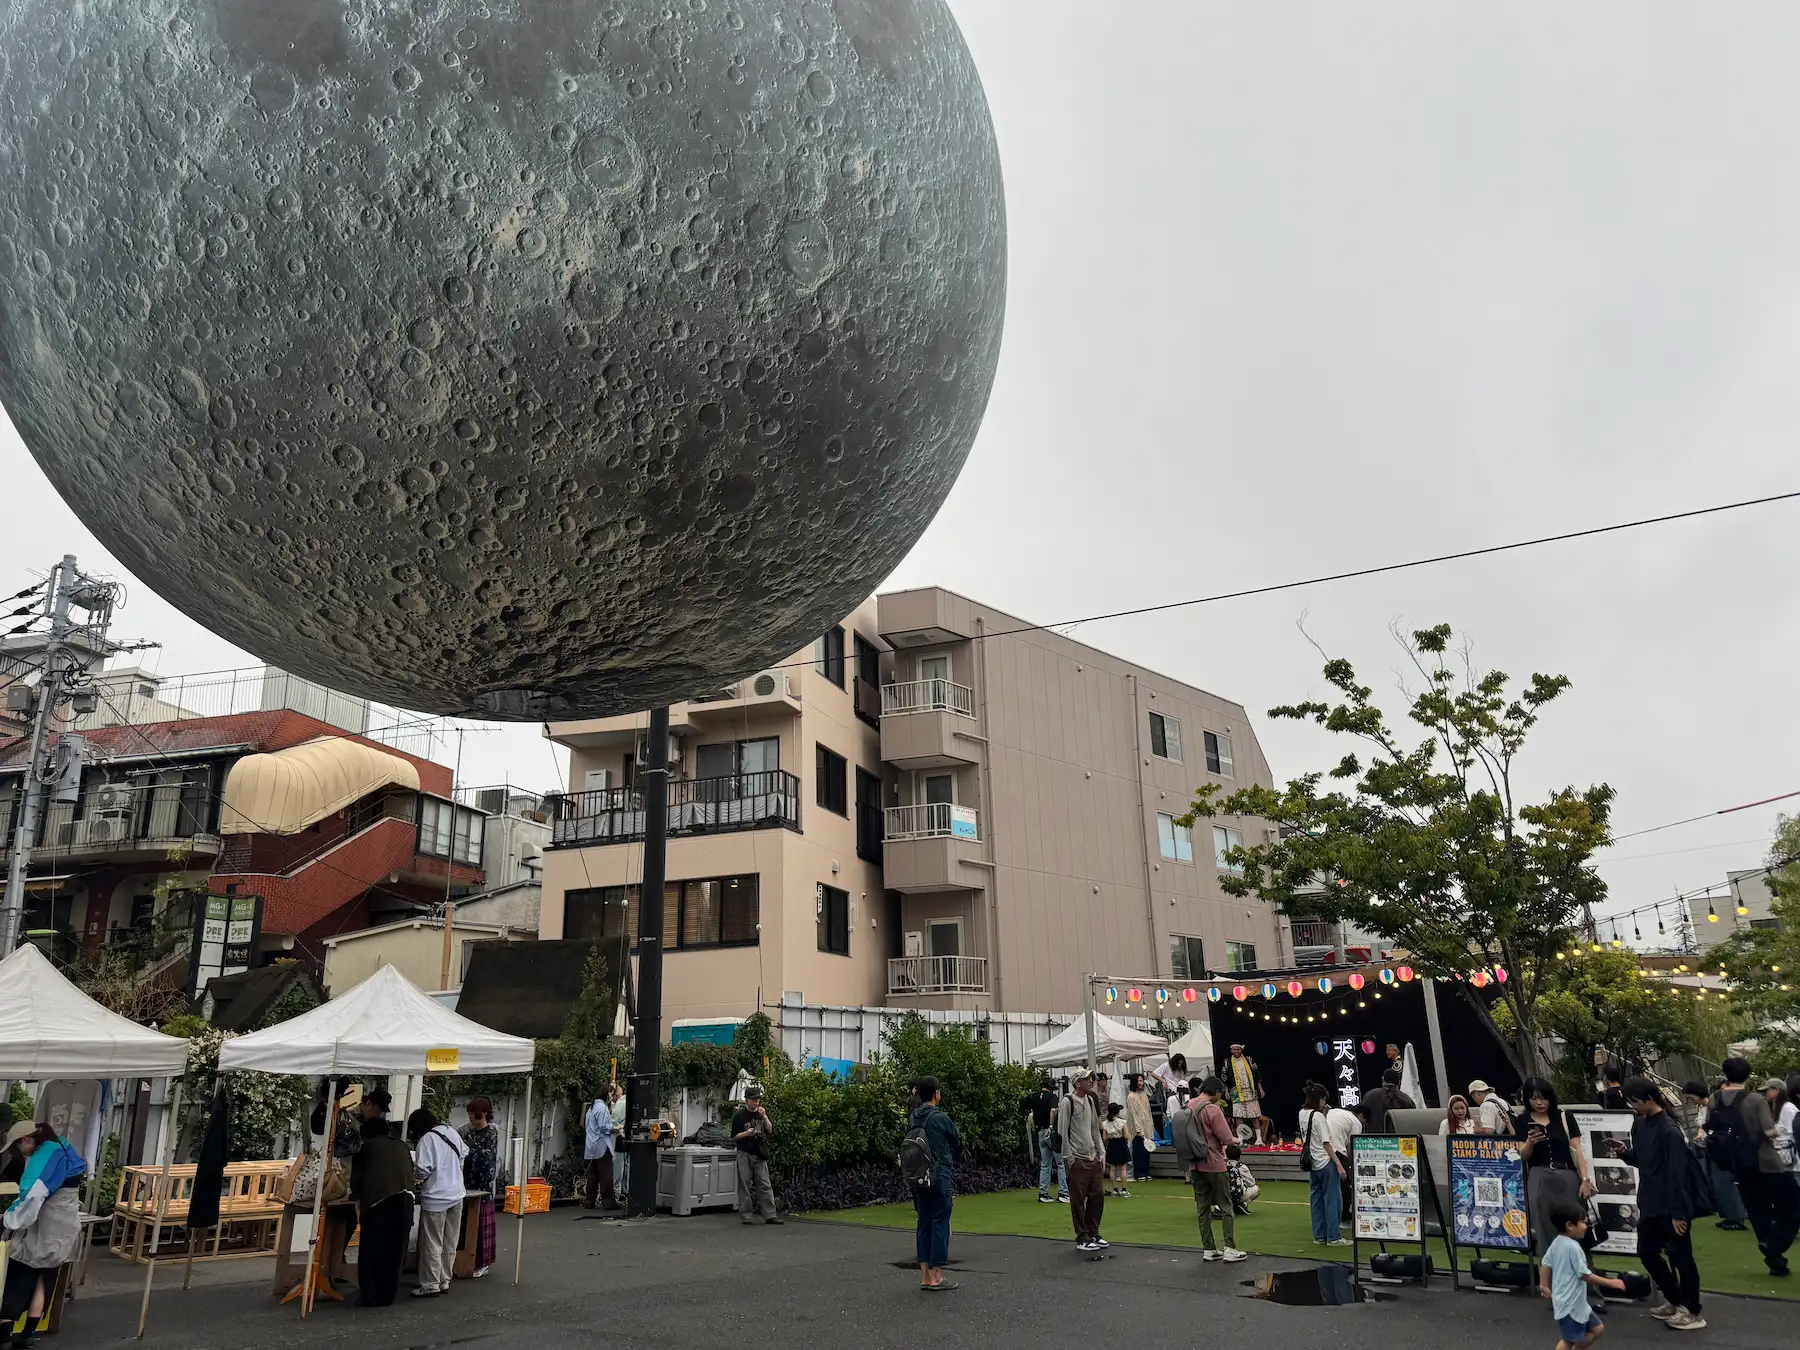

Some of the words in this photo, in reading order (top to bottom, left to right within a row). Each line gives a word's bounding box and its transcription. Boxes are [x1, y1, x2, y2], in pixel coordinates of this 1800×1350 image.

[1332, 1038, 1360, 1108] 天々高
[1452, 1140, 1475, 1149] MOON
[1477, 1140, 1493, 1150] ART
[1452, 1149, 1478, 1158] STAMP
[1480, 1150, 1503, 1160] RALLY
